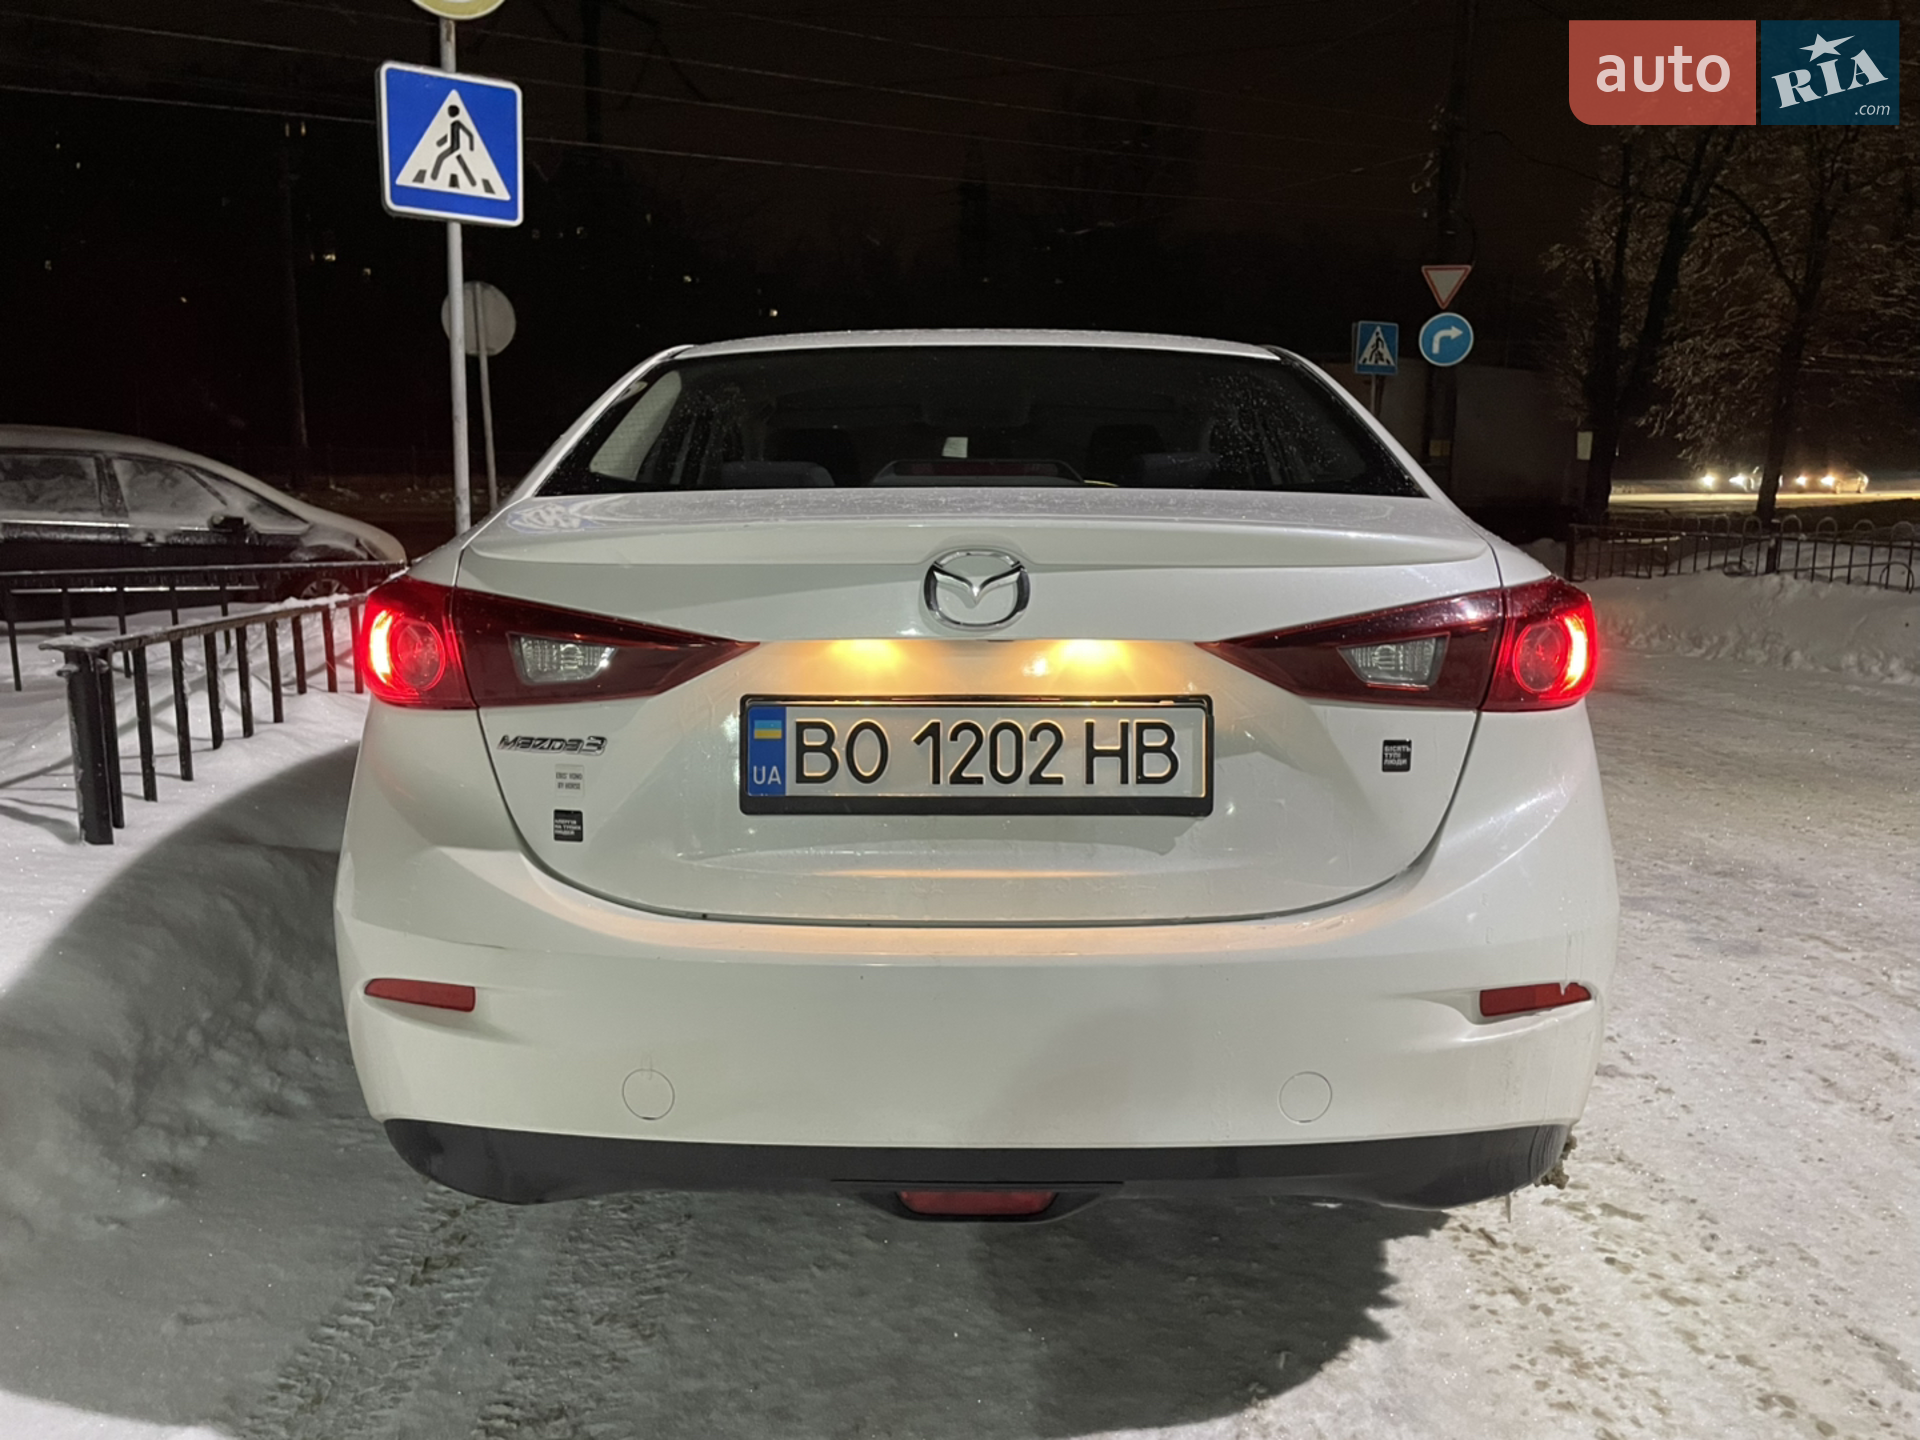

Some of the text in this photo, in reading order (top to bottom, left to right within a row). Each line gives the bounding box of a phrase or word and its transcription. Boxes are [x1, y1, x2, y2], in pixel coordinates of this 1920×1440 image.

[795, 719, 1180, 785] BO 1202 HB
[752, 765, 782, 786] UA
